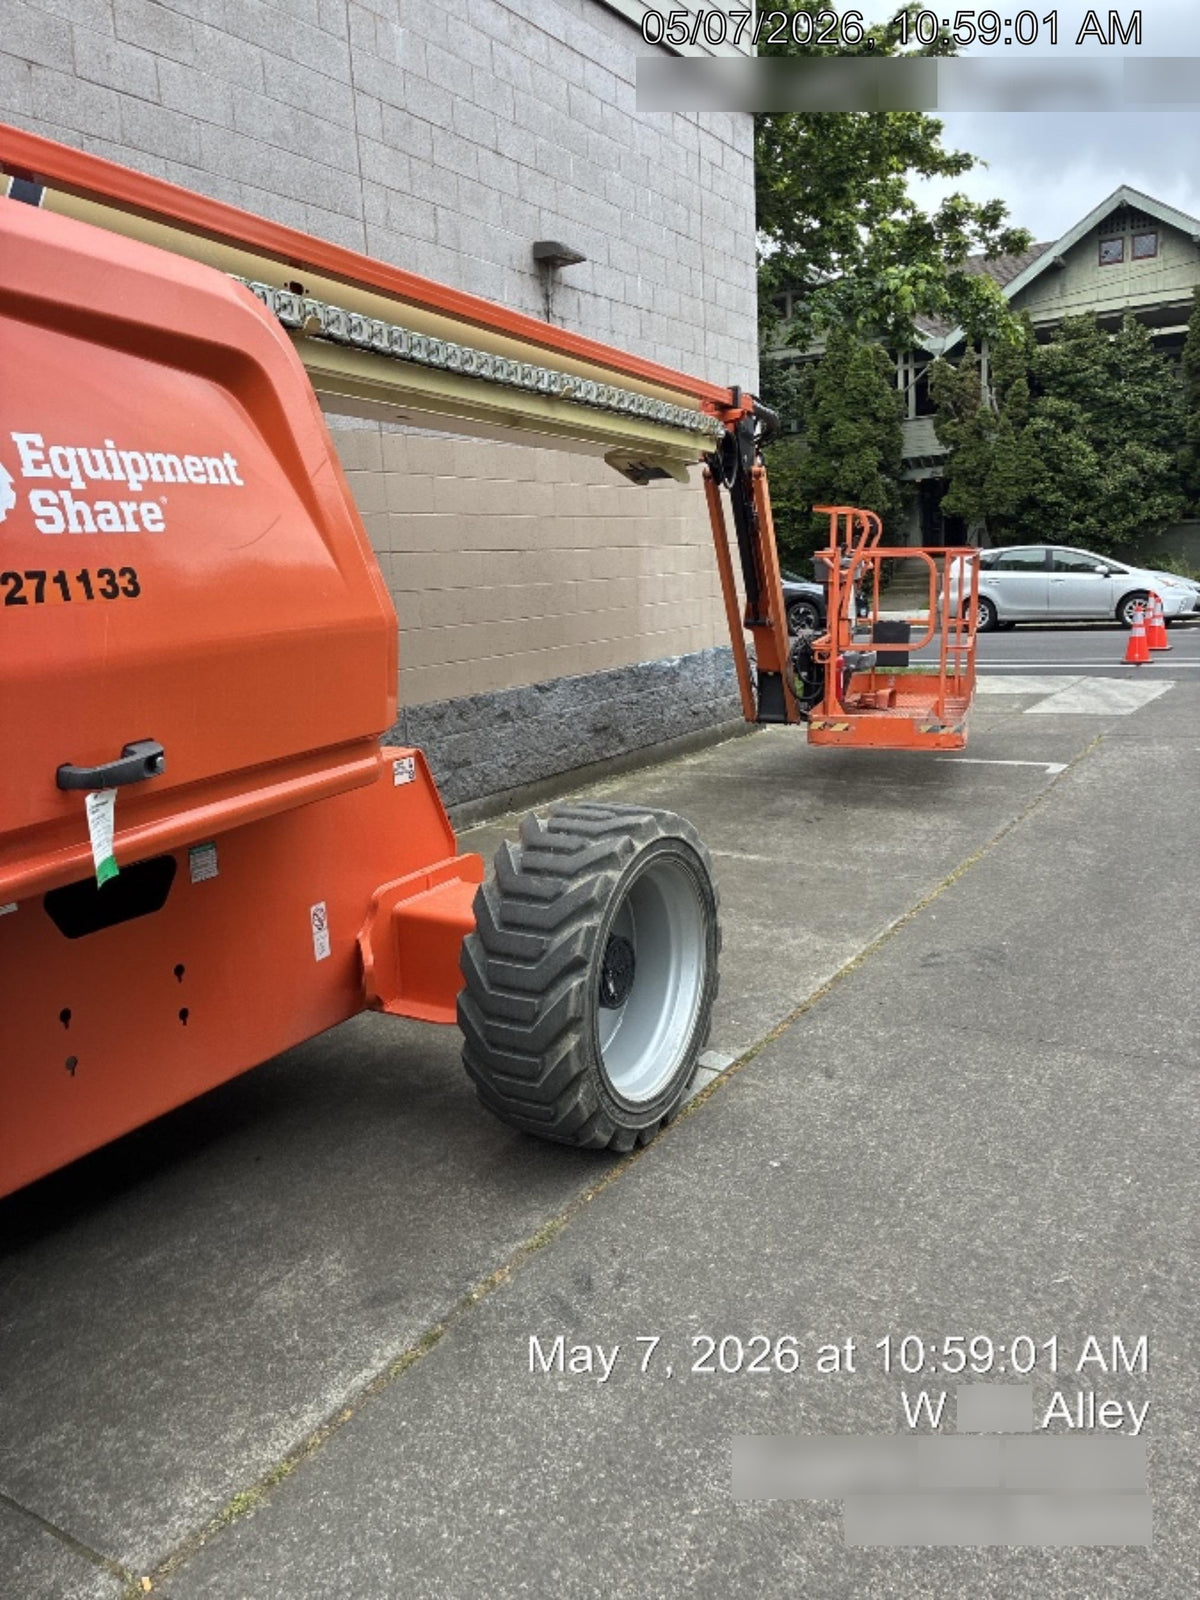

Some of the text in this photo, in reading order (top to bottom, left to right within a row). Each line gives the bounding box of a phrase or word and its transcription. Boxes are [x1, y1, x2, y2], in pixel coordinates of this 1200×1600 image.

[10, 431, 245, 491] Equipment
[28, 488, 166, 535] Share
[0, 566, 141, 606] 271133
